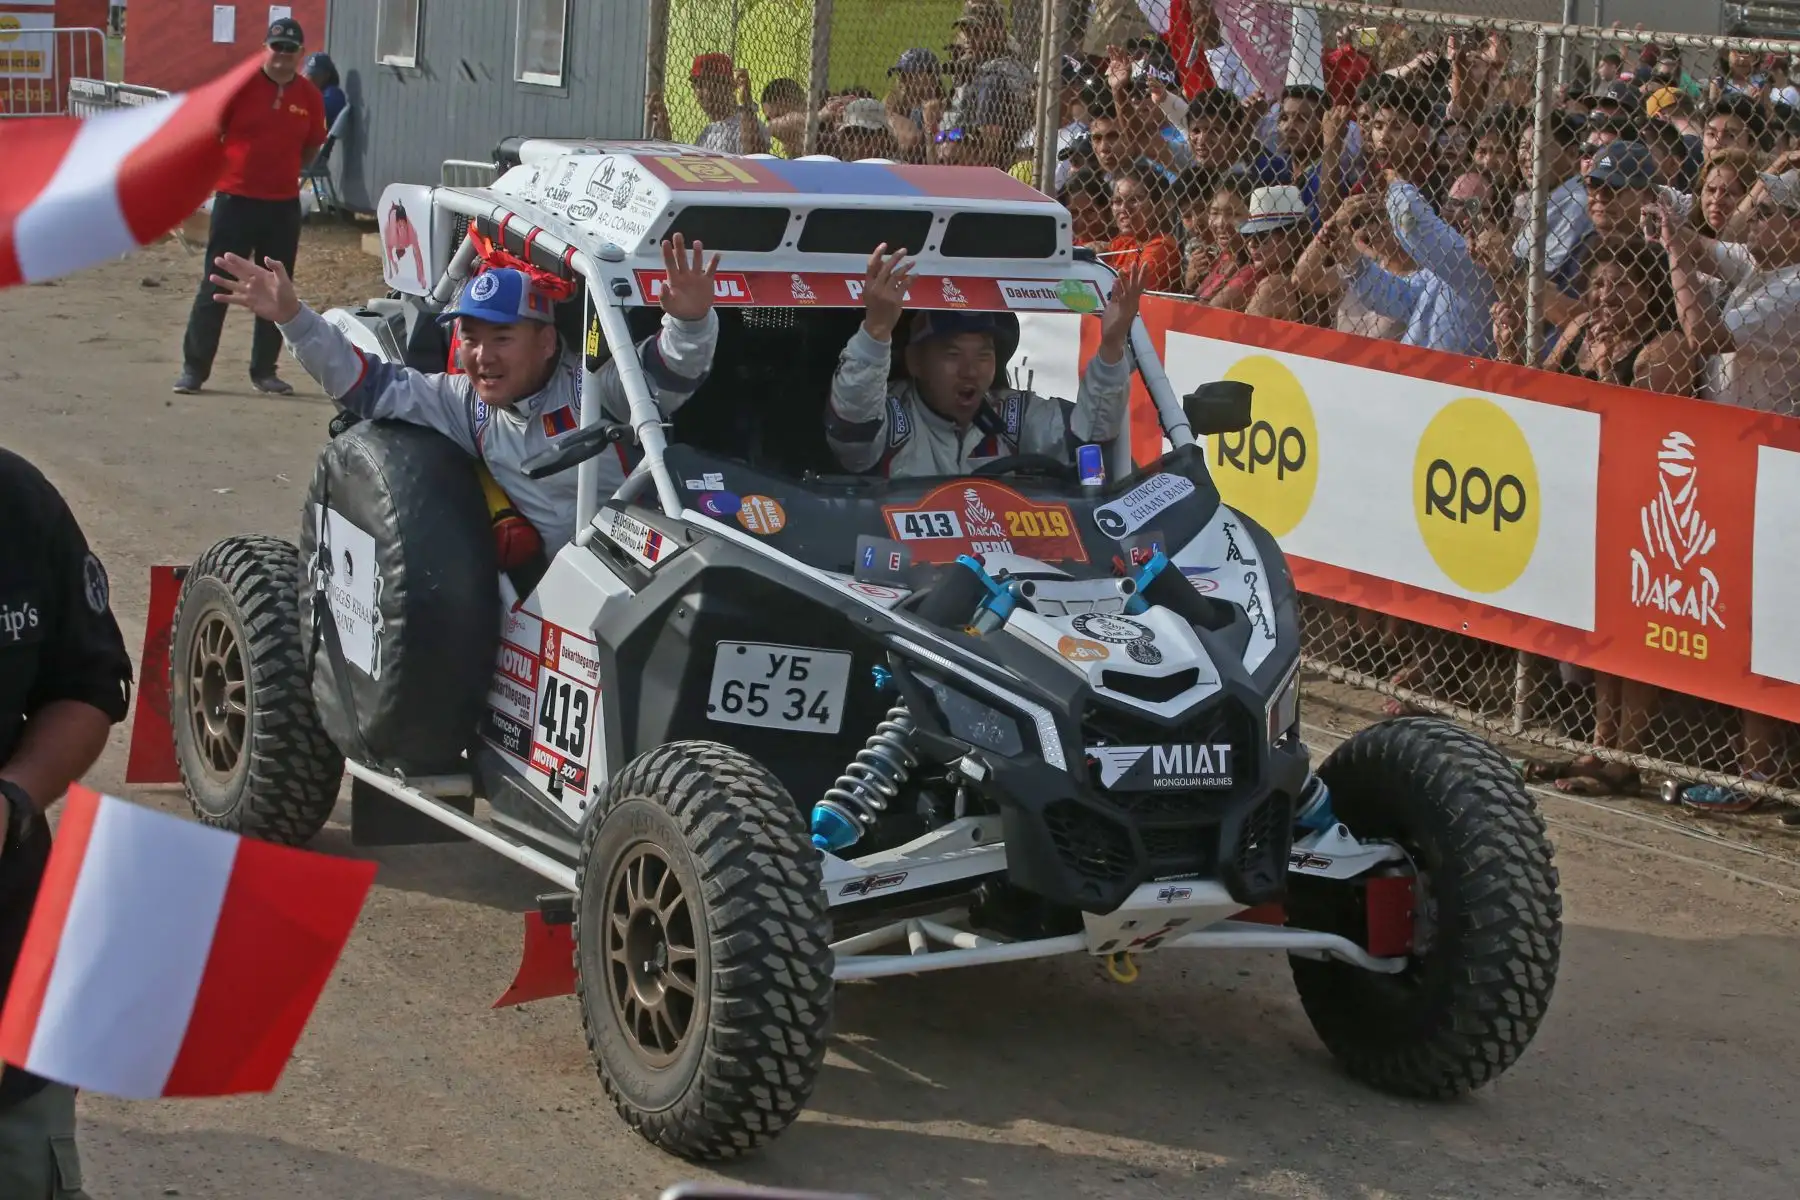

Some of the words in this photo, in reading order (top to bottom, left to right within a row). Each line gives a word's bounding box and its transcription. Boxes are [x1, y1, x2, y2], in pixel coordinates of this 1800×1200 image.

[611, 215, 649, 236] COMPANY
[1005, 287, 1059, 300] Dakarth
[1123, 474, 1171, 508] CHINGGIS
[1131, 495, 1166, 521] KHAAN
[1163, 479, 1193, 501] BANK
[763, 500, 781, 528] BALISE
[905, 513, 954, 538] 413
[965, 520, 1006, 537] DAKAR
[1004, 511, 1071, 537] 2019
[1630, 548, 1726, 630] DAKAR
[1645, 621, 1708, 660] 2019
[561, 645, 600, 671] Dakarthegame
[766, 653, 812, 682] УБ
[721, 679, 770, 718] 65
[782, 687, 830, 725] 34
[539, 675, 588, 759] 413
[503, 734, 520, 751] sport
[533, 748, 559, 772] MOTUL
[1153, 744, 1232, 775] MIAT
[1153, 778, 1201, 788] MONGOLIAN
[1202, 777, 1233, 787] AIRLINES
